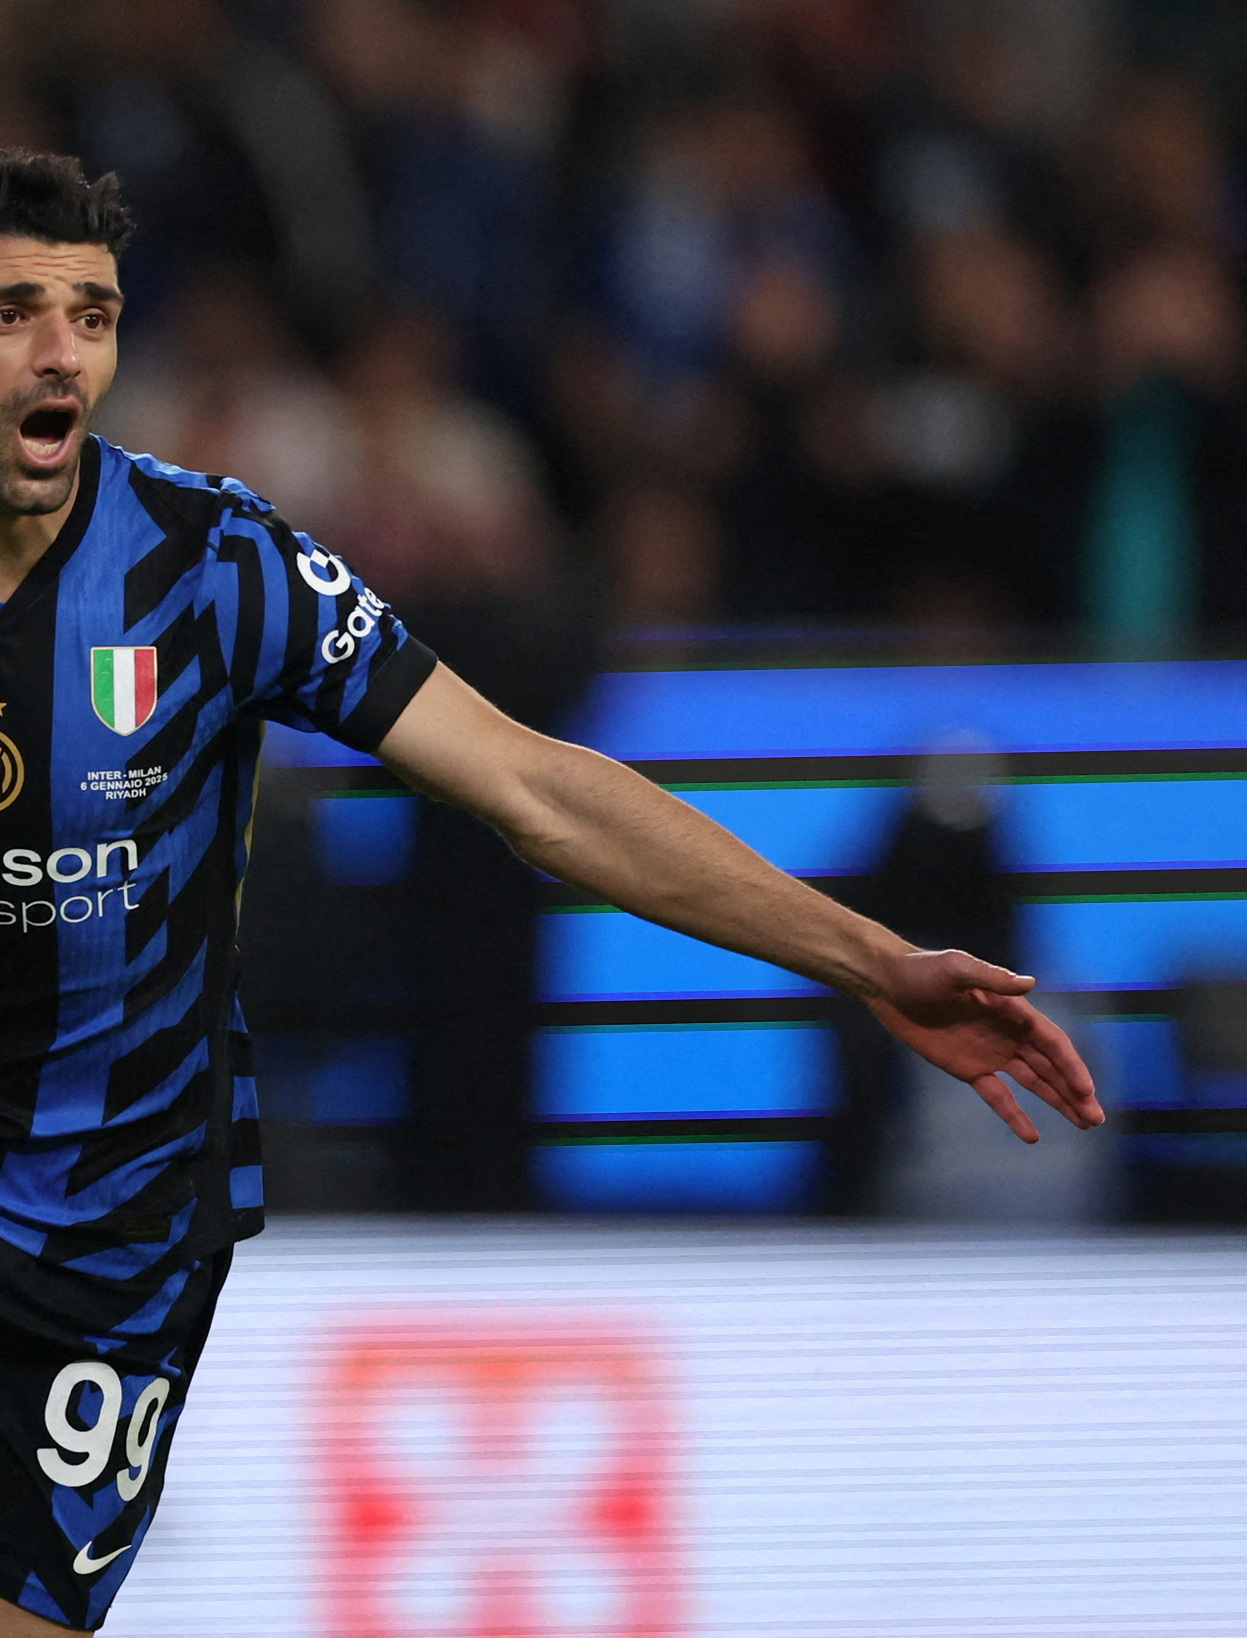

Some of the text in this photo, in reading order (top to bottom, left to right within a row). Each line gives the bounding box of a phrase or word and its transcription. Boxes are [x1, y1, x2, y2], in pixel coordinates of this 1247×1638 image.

[80, 772, 168, 791] 6 GENNAIO 2025
[105, 787, 147, 800] RIYADH
[36, 1361, 170, 1502] 99
